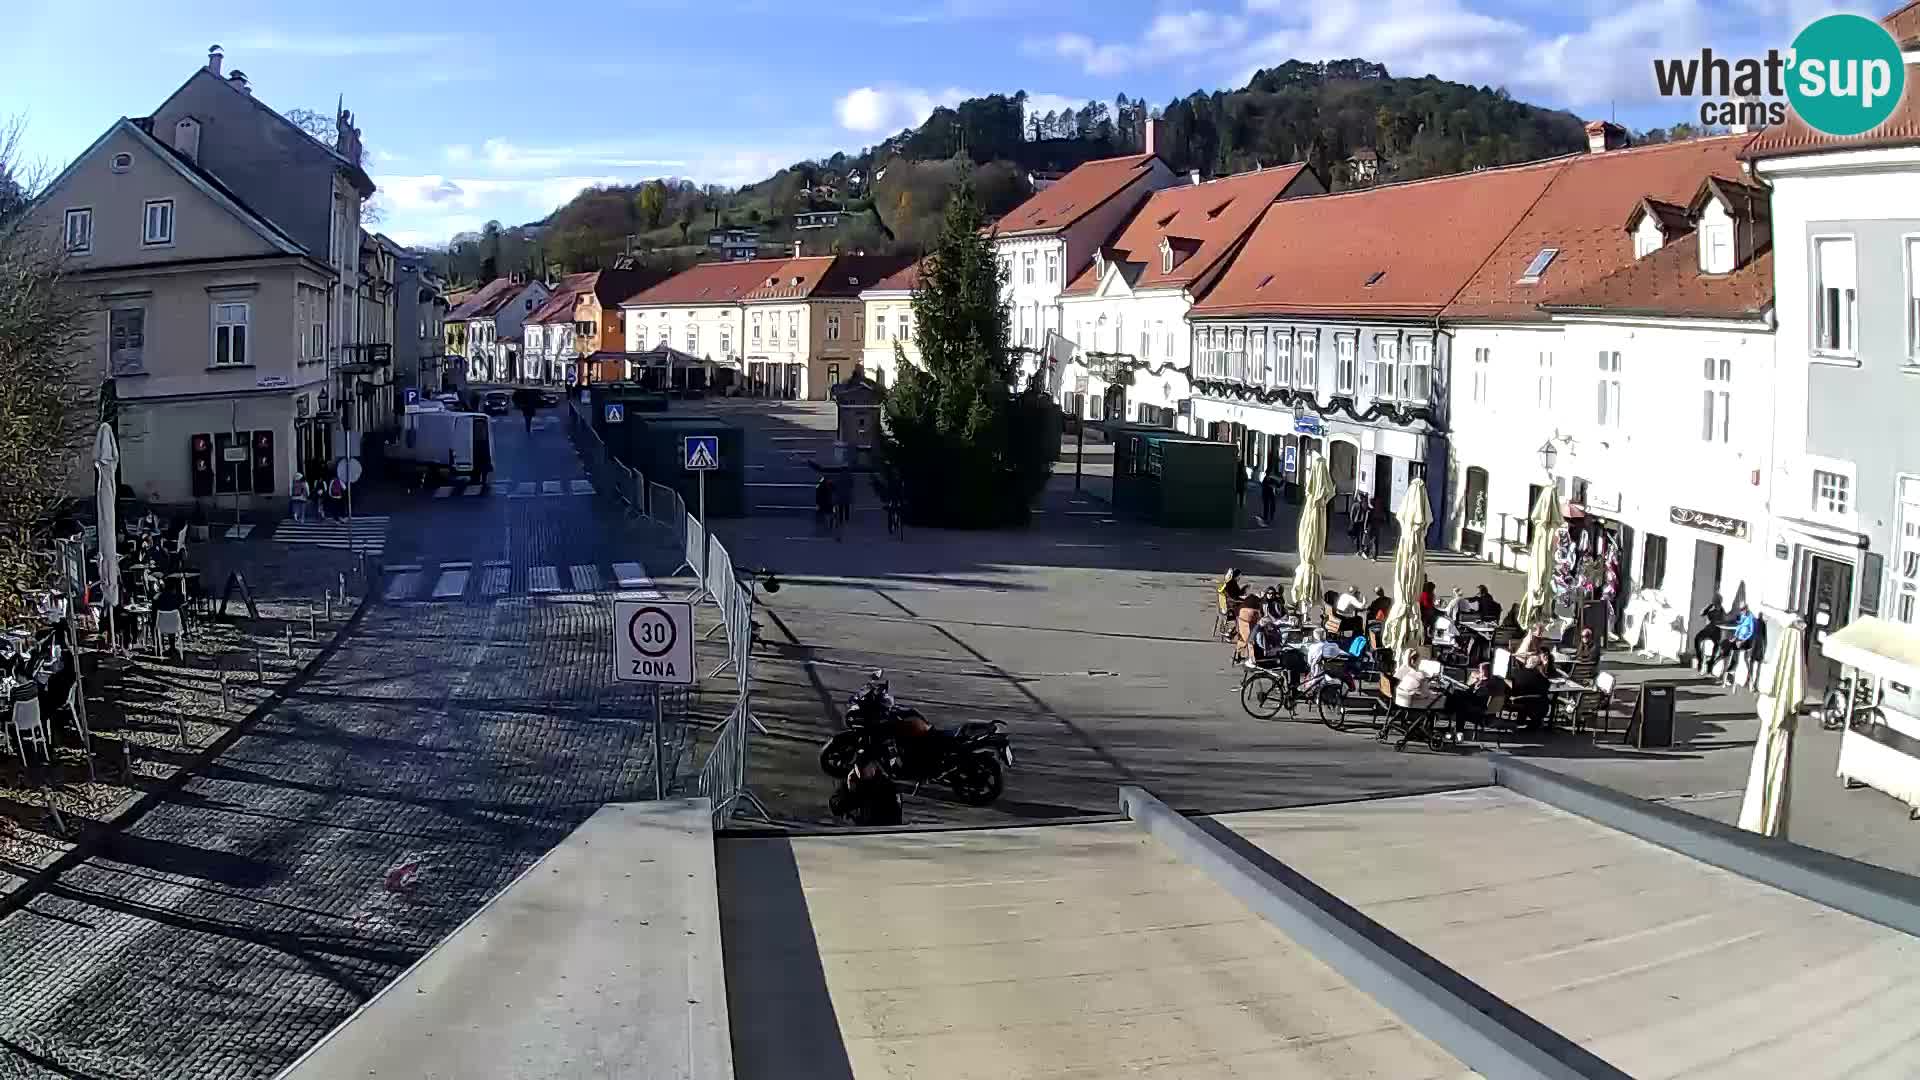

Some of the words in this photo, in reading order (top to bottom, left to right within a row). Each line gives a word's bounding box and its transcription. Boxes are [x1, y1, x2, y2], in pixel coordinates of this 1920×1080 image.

[408, 391, 417, 403] P
[641, 622, 666, 644] 30
[631, 660, 676, 677] ZONA
